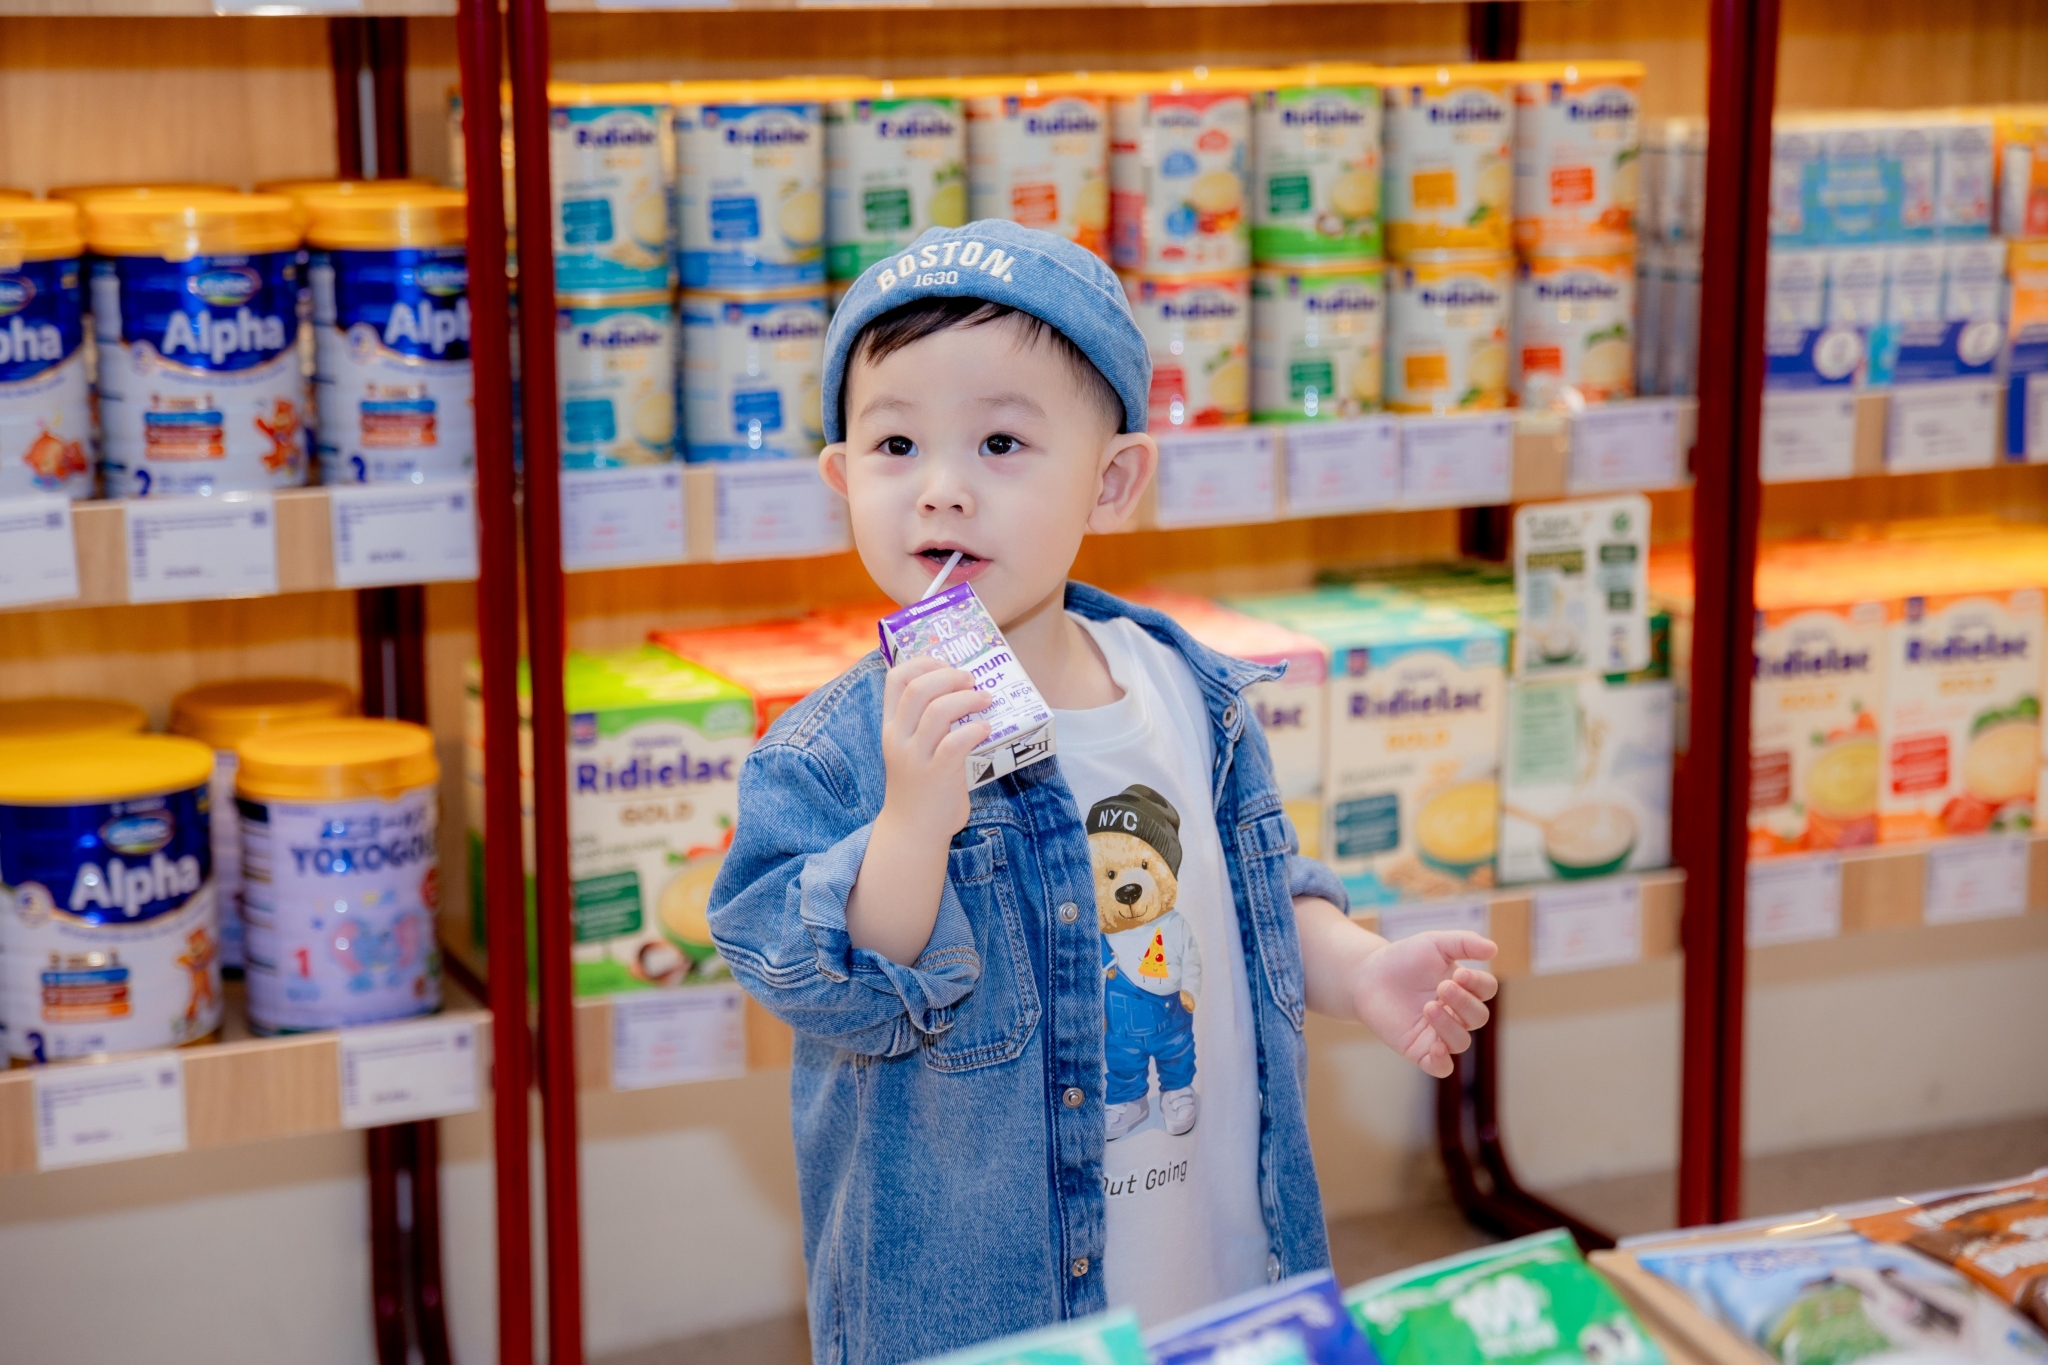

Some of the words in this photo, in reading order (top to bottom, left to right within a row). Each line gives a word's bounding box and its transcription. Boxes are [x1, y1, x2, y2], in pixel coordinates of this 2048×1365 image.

[913, 271, 959, 287] 1630
[161, 307, 285, 365] Alpha
[932, 618, 958, 643] A2
[942, 631, 983, 665] HMO
[576, 754, 734, 795] Ridielac
[621, 803, 693, 827] GOLD
[1098, 809, 1138, 831] NYC
[68, 851, 200, 918] Alpha
[294, 947, 311, 979] 1
[1145, 1160, 1188, 1190] Going
